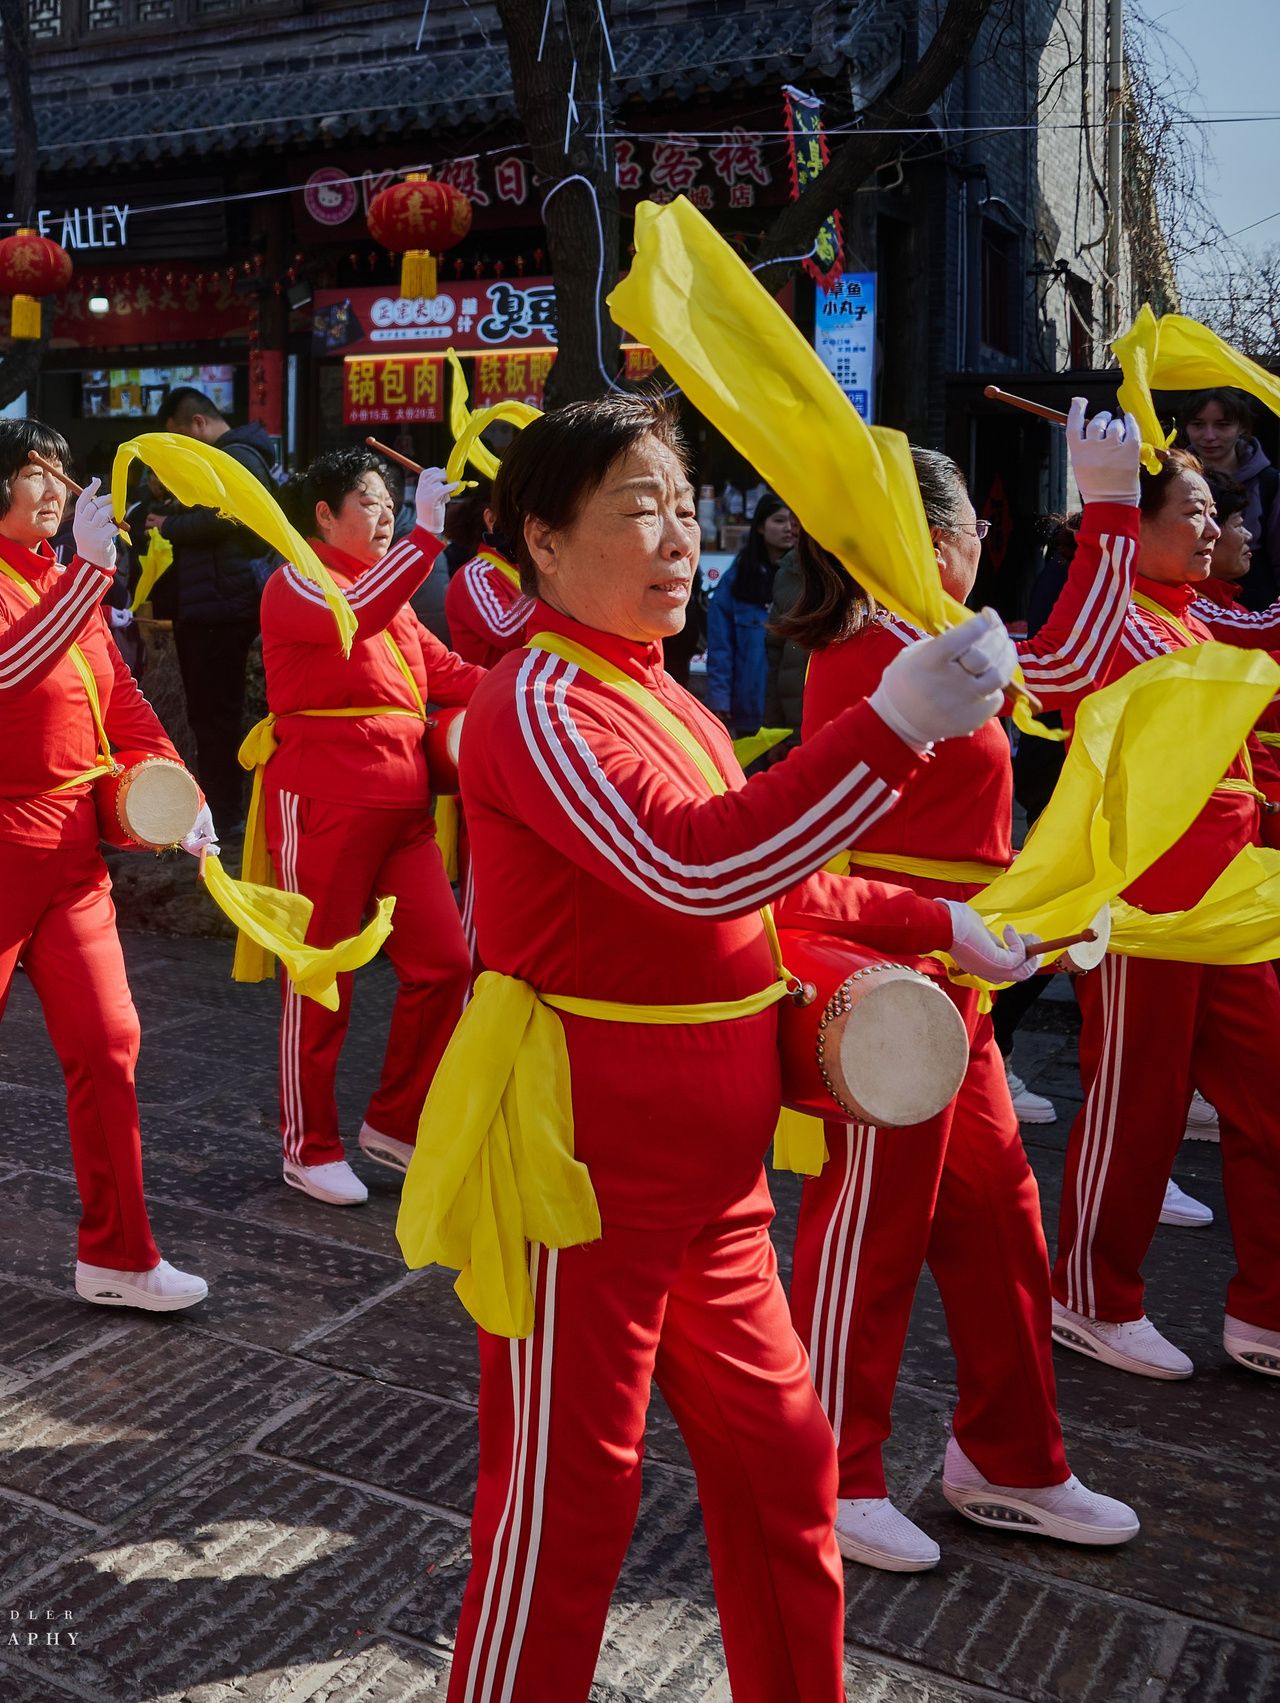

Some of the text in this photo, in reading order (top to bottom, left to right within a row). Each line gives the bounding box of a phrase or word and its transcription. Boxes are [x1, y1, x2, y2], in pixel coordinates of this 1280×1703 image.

[61, 203, 130, 249] ALLEY
[477, 281, 559, 344] 臭豆
[822, 300, 868, 321] 小丸子
[347, 357, 439, 406] 锅包肉
[349, 408, 437, 421] 小份15元 大份20元
